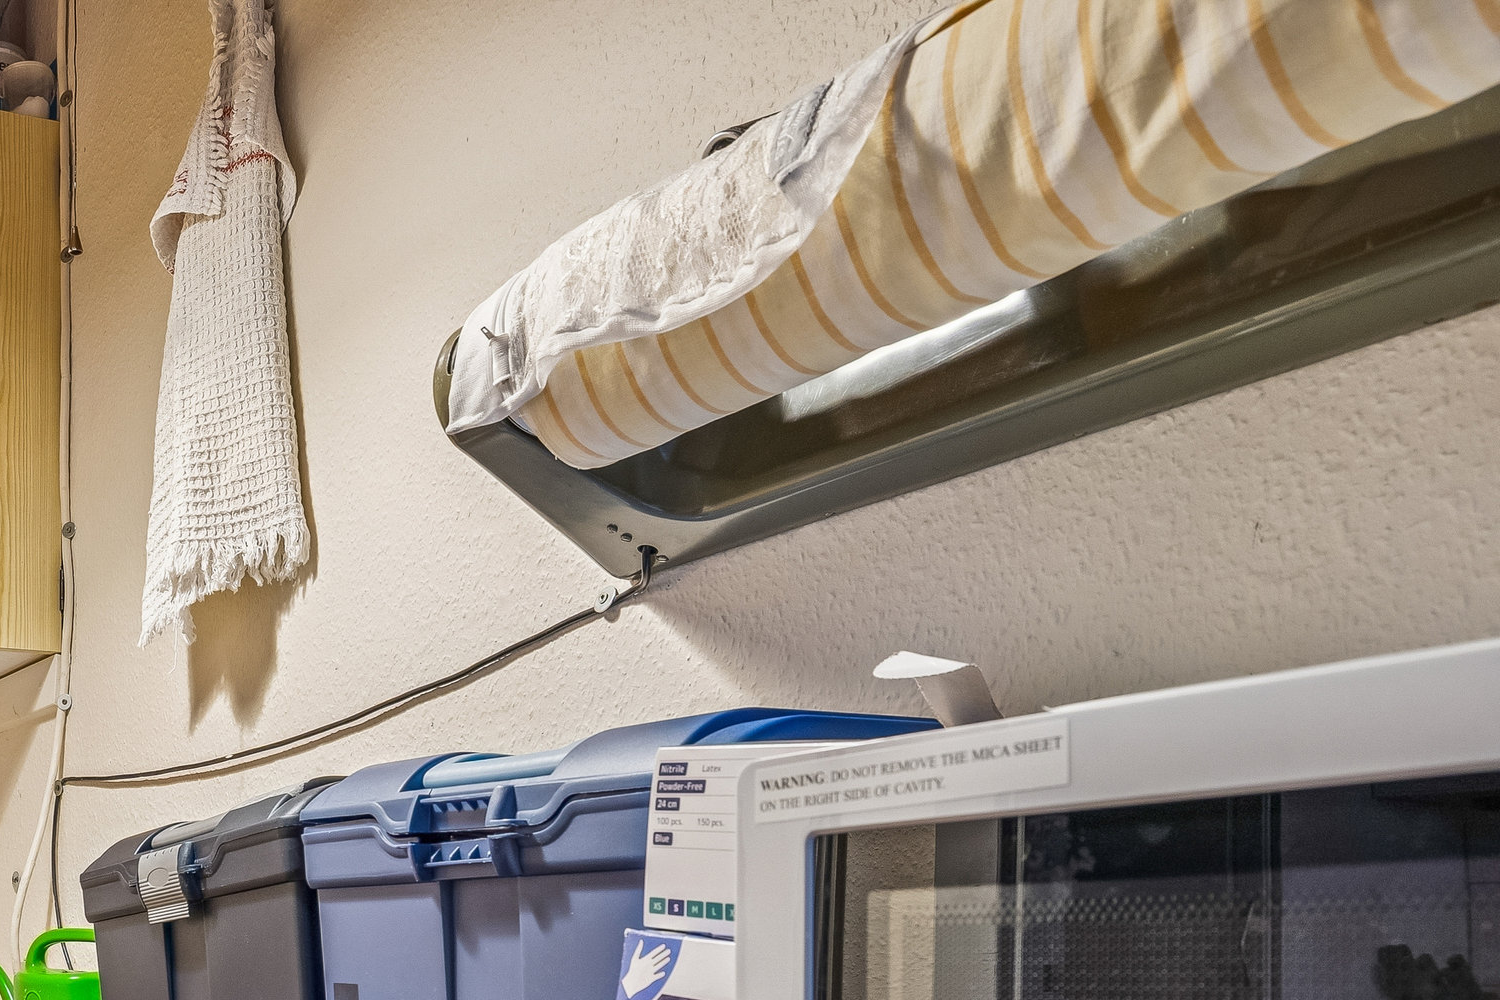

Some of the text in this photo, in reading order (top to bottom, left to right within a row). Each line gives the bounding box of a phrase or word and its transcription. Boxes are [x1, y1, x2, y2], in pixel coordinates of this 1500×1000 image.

[831, 770, 849, 782] DO
[852, 764, 878, 779] NOT
[880, 758, 937, 776] REMOVE
[941, 752, 967, 767] THE
[972, 745, 1010, 762] MICA
[1014, 736, 1063, 754] SHEET
[661, 765, 721, 773] Nitrile Latex
[659, 782, 703, 791] Powder-Free
[759, 799, 777, 813] ON
[779, 796, 801, 810] THE
[803, 790, 840, 808] RIGHT
[843, 787, 870, 802] SIDE
[874, 784, 891, 797] OF
[657, 800, 666, 808] 24
[657, 817, 669, 825] 100
[697, 818, 710, 827] 150
[654, 833, 670, 843] Blue
[653, 902, 662, 911] XS
[673, 903, 679, 912] S
[691, 905, 698, 914] M
